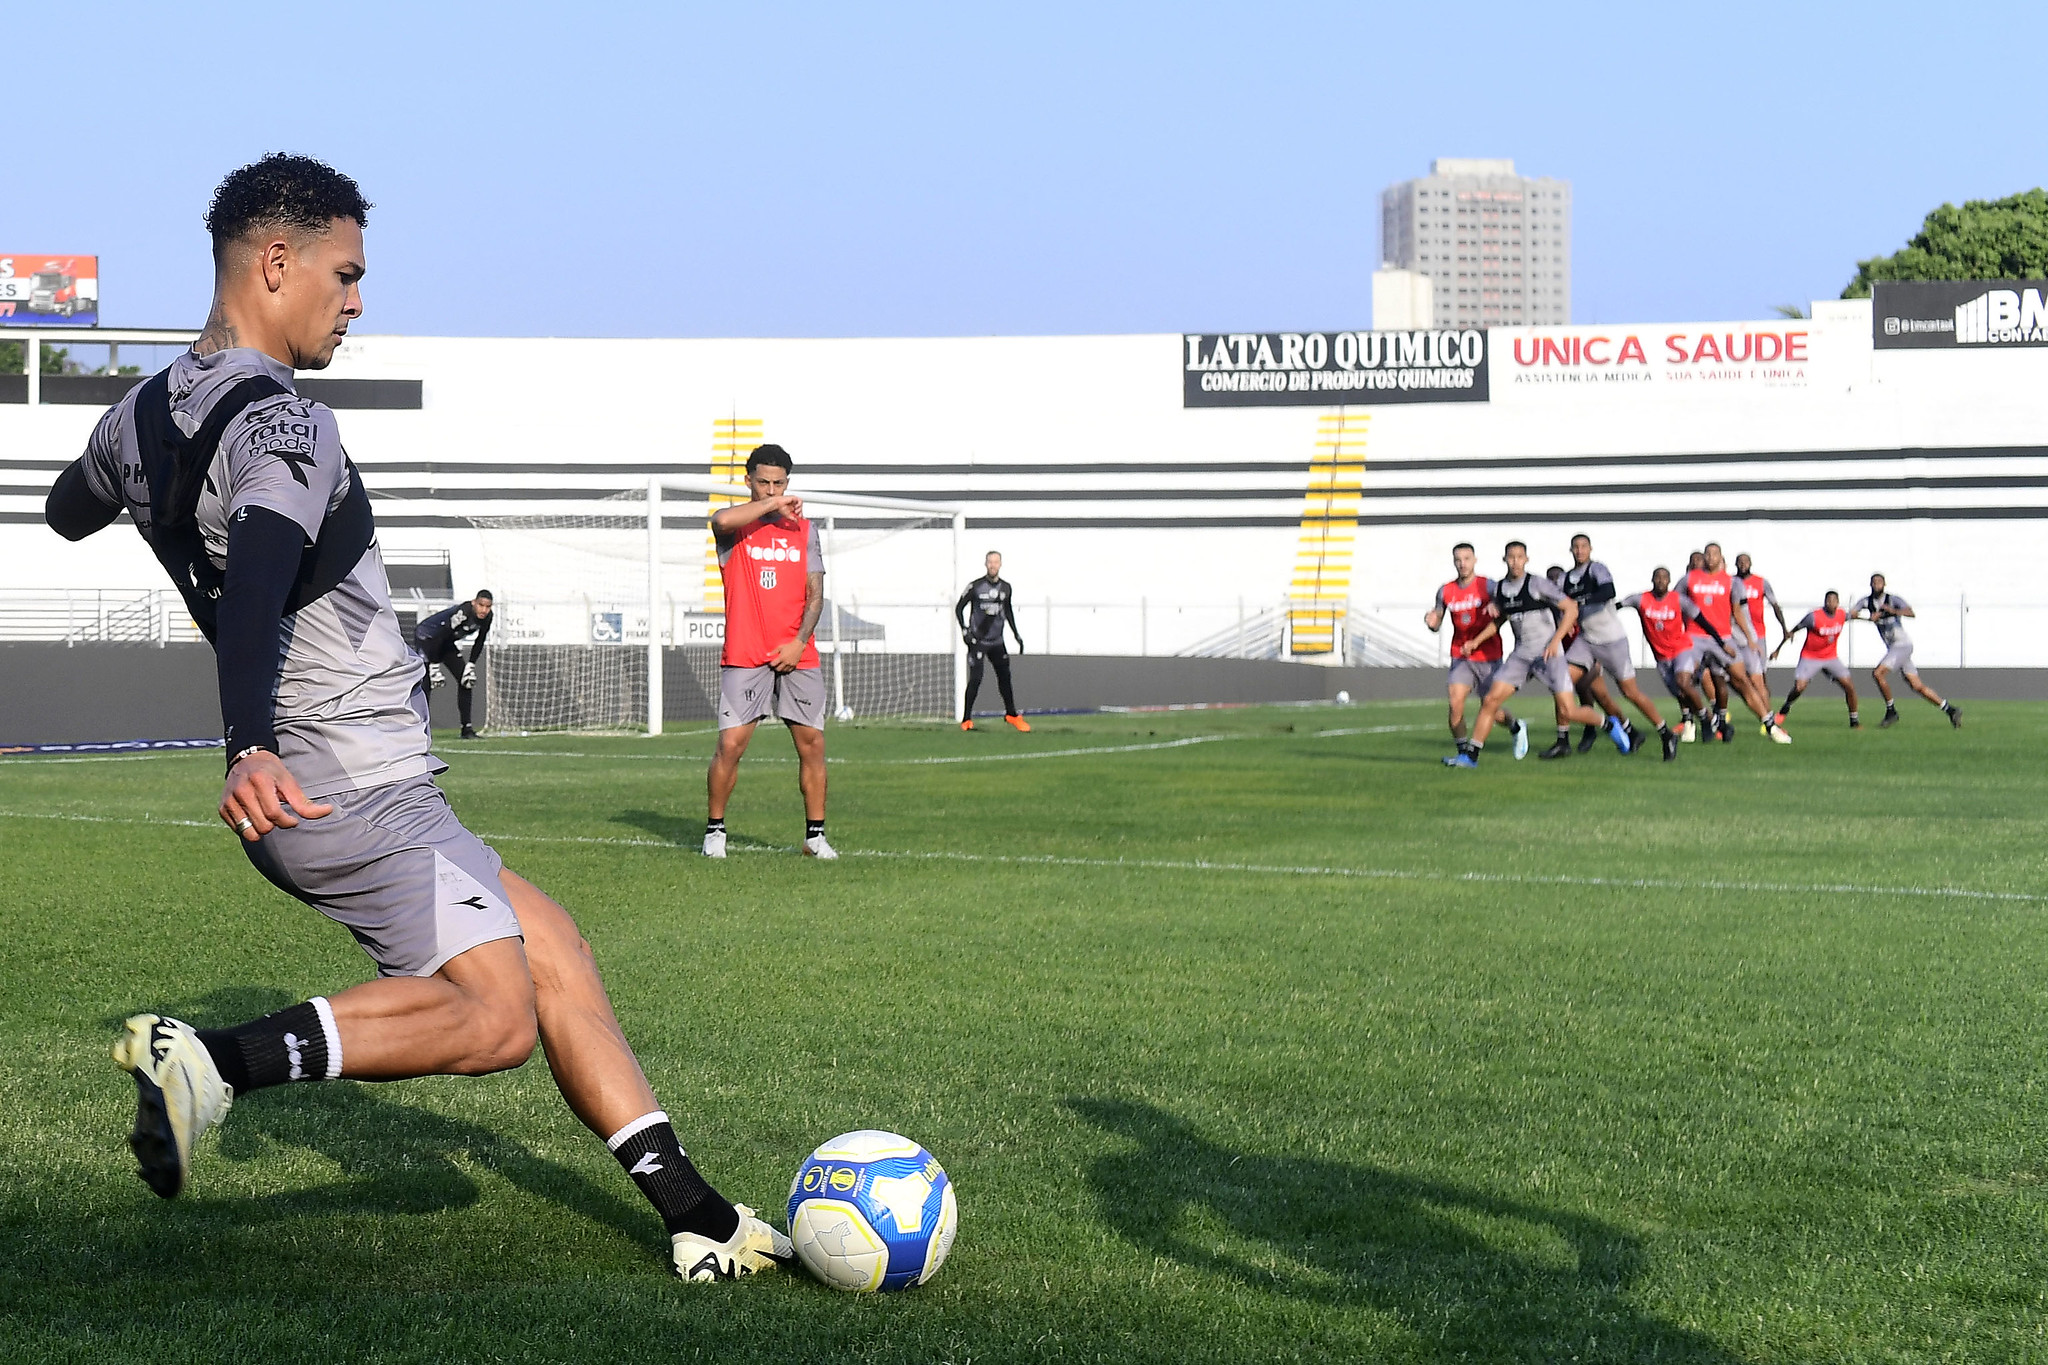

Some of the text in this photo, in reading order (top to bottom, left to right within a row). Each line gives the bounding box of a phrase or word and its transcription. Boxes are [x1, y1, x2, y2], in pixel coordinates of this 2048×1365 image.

[1334, 330, 1484, 371] QUIMICO
[1201, 368, 1475, 392] COMERCIO DE PRODUTOS QUIMICOS
[248, 436, 317, 458] model
